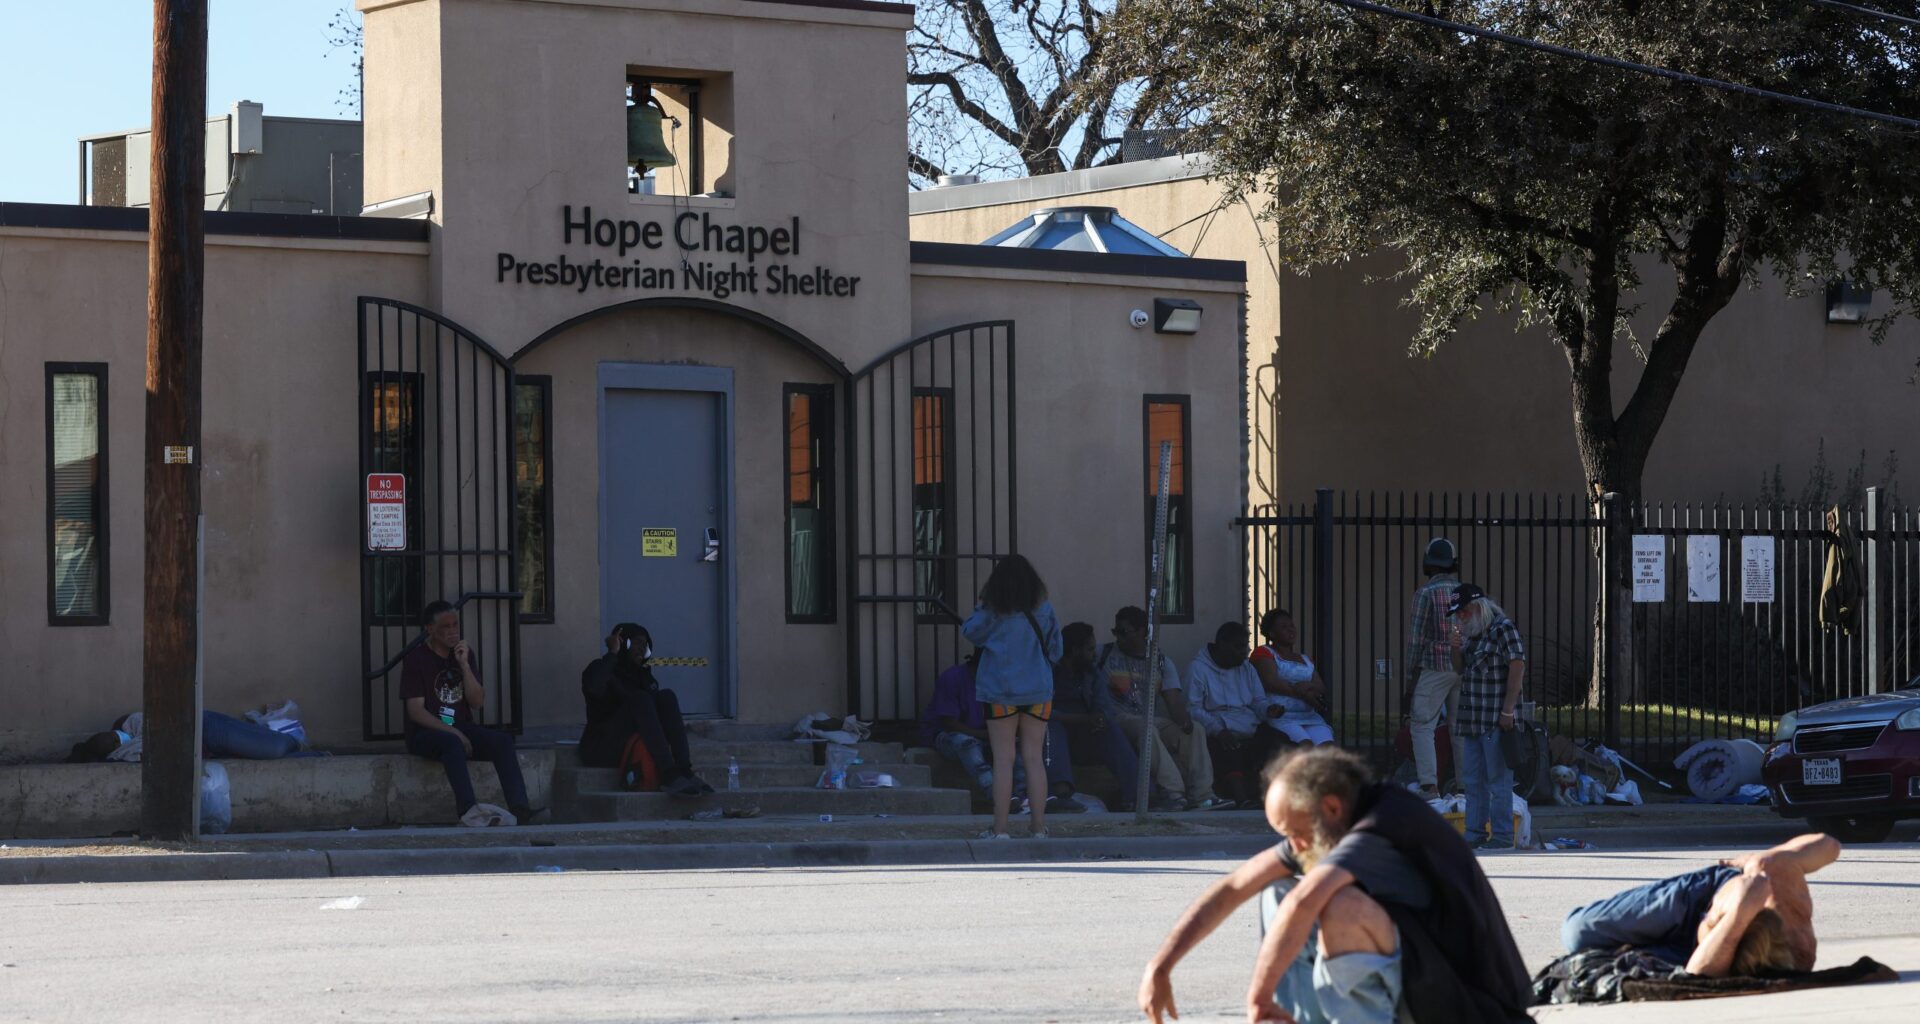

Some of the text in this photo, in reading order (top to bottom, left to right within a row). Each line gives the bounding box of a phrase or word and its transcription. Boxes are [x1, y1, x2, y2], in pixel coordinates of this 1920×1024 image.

[563, 205, 800, 261] Hope Chapel
[497, 253, 861, 299] Presbyterian Night Shelter
[369, 490, 402, 499] TRESPASSING
[380, 480, 391, 489] NO
